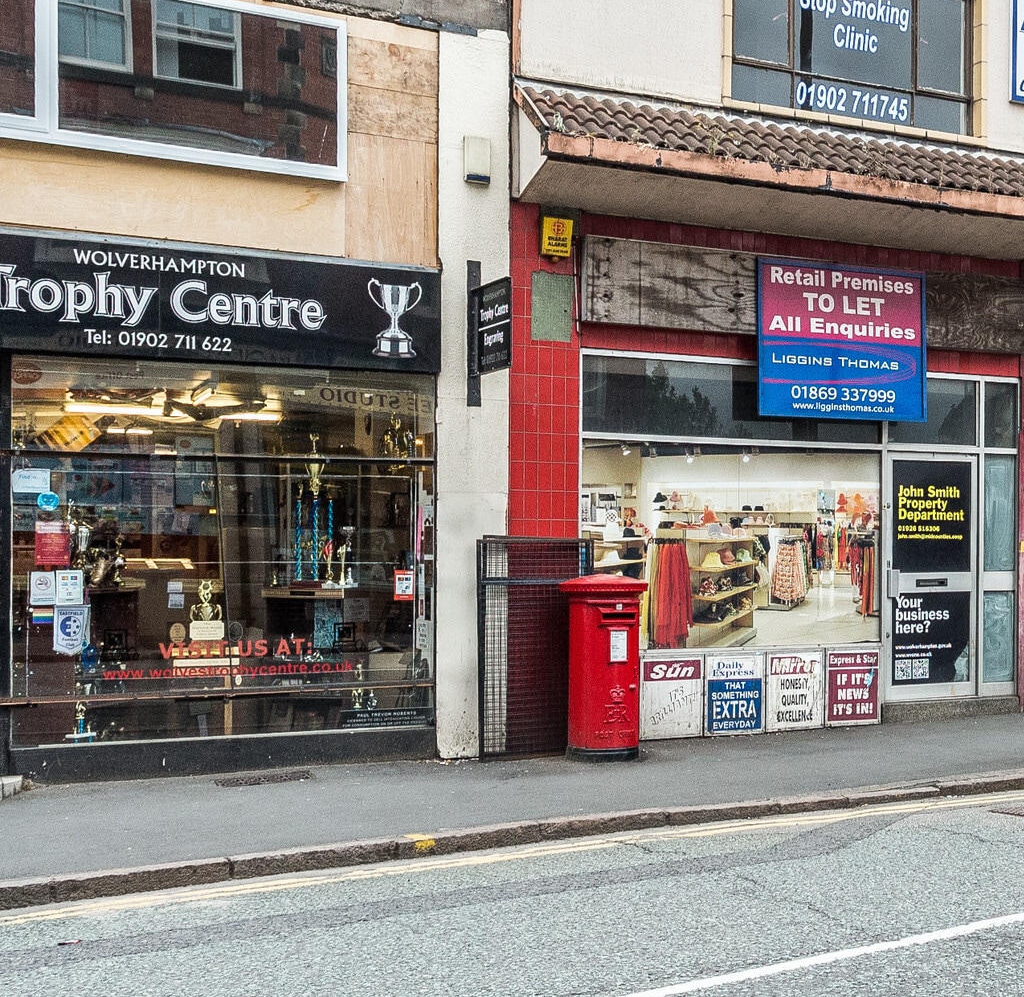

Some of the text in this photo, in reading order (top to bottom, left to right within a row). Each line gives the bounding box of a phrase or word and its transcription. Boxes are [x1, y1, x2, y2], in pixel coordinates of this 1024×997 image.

[833, 24, 878, 53] Clinic
[796, 81, 908, 122] 01902 711745
[73, 249, 245, 277] WOLVERHAMPTON
[771, 266, 914, 294] Retail Premises
[170, 279, 327, 331] Centre
[803, 292, 885, 316] TO LET
[480, 304, 509, 322] Trophy Centre
[769, 315, 915, 340] All Enquiries
[84, 329, 112, 344] Tel:
[118, 331, 168, 348] 01902
[174, 335, 196, 350] 711
[202, 336, 232, 352] 622
[484, 330, 504, 346] Engraving
[772, 353, 899, 370] LIGGINS THOMAS
[791, 385, 896, 402] 01869 337999
[792, 401, 894, 413] www.ligginsthomas.co.uk
[898, 485, 960, 498] John Smith
[899, 497, 947, 511] Property
[899, 508, 964, 522] Department
[895, 596, 923, 608] Your
[895, 608, 950, 621] business
[895, 621, 931, 634] here?
[159, 638, 313, 659] VISIT US AT:
[717, 661, 744, 670] Daily
[830, 654, 877, 666] Express & Star
[103, 660, 353, 680] www.wolvestrophycentre.co.uk
[650, 664, 694, 679] Sun
[713, 669, 754, 678] Express
[724, 682, 746, 690] THAT
[837, 673, 870, 685] IF IT'S
[711, 690, 759, 700] SOMETHING
[781, 693, 809, 707] QUALITY,
[837, 688, 869, 700] NEWS
[713, 701, 757, 719] EXTRA
[777, 709, 813, 723] EXCELLENCE
[833, 703, 873, 715] IT'S IN!
[713, 720, 756, 729] EVERYDAY
